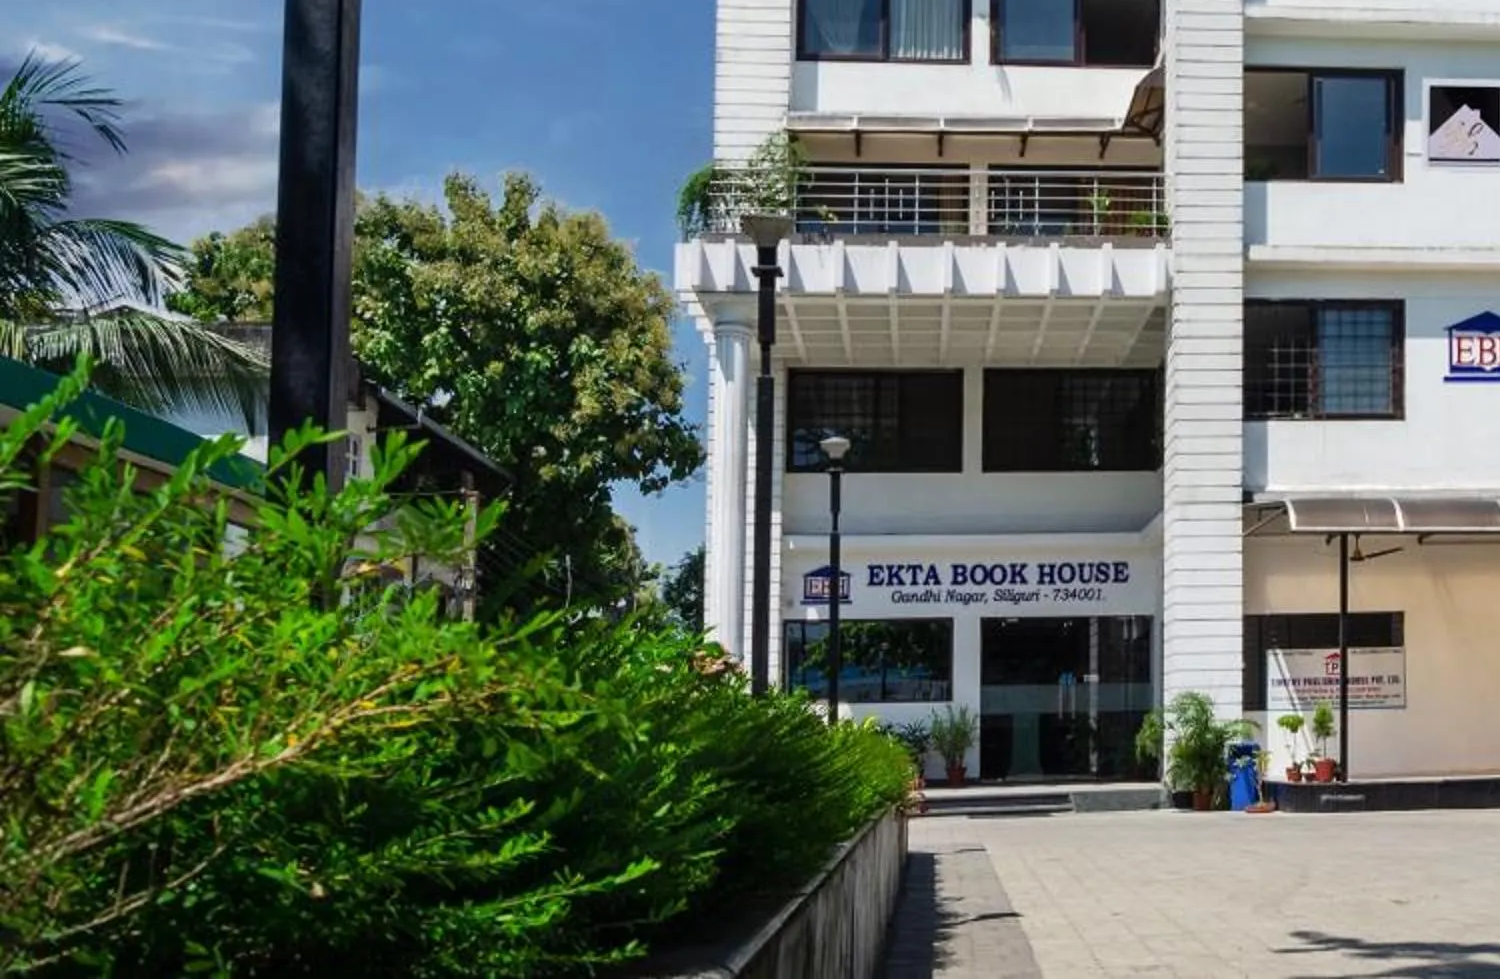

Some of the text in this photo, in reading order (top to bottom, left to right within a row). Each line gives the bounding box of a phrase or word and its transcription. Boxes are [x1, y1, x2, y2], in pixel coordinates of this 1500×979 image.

[866, 562, 1130, 587] EKTA BOOK HOUSE
[891, 587, 941, 604] Gandhi
[944, 588, 988, 605] Nagar,
[992, 587, 1041, 605] Siliguri
